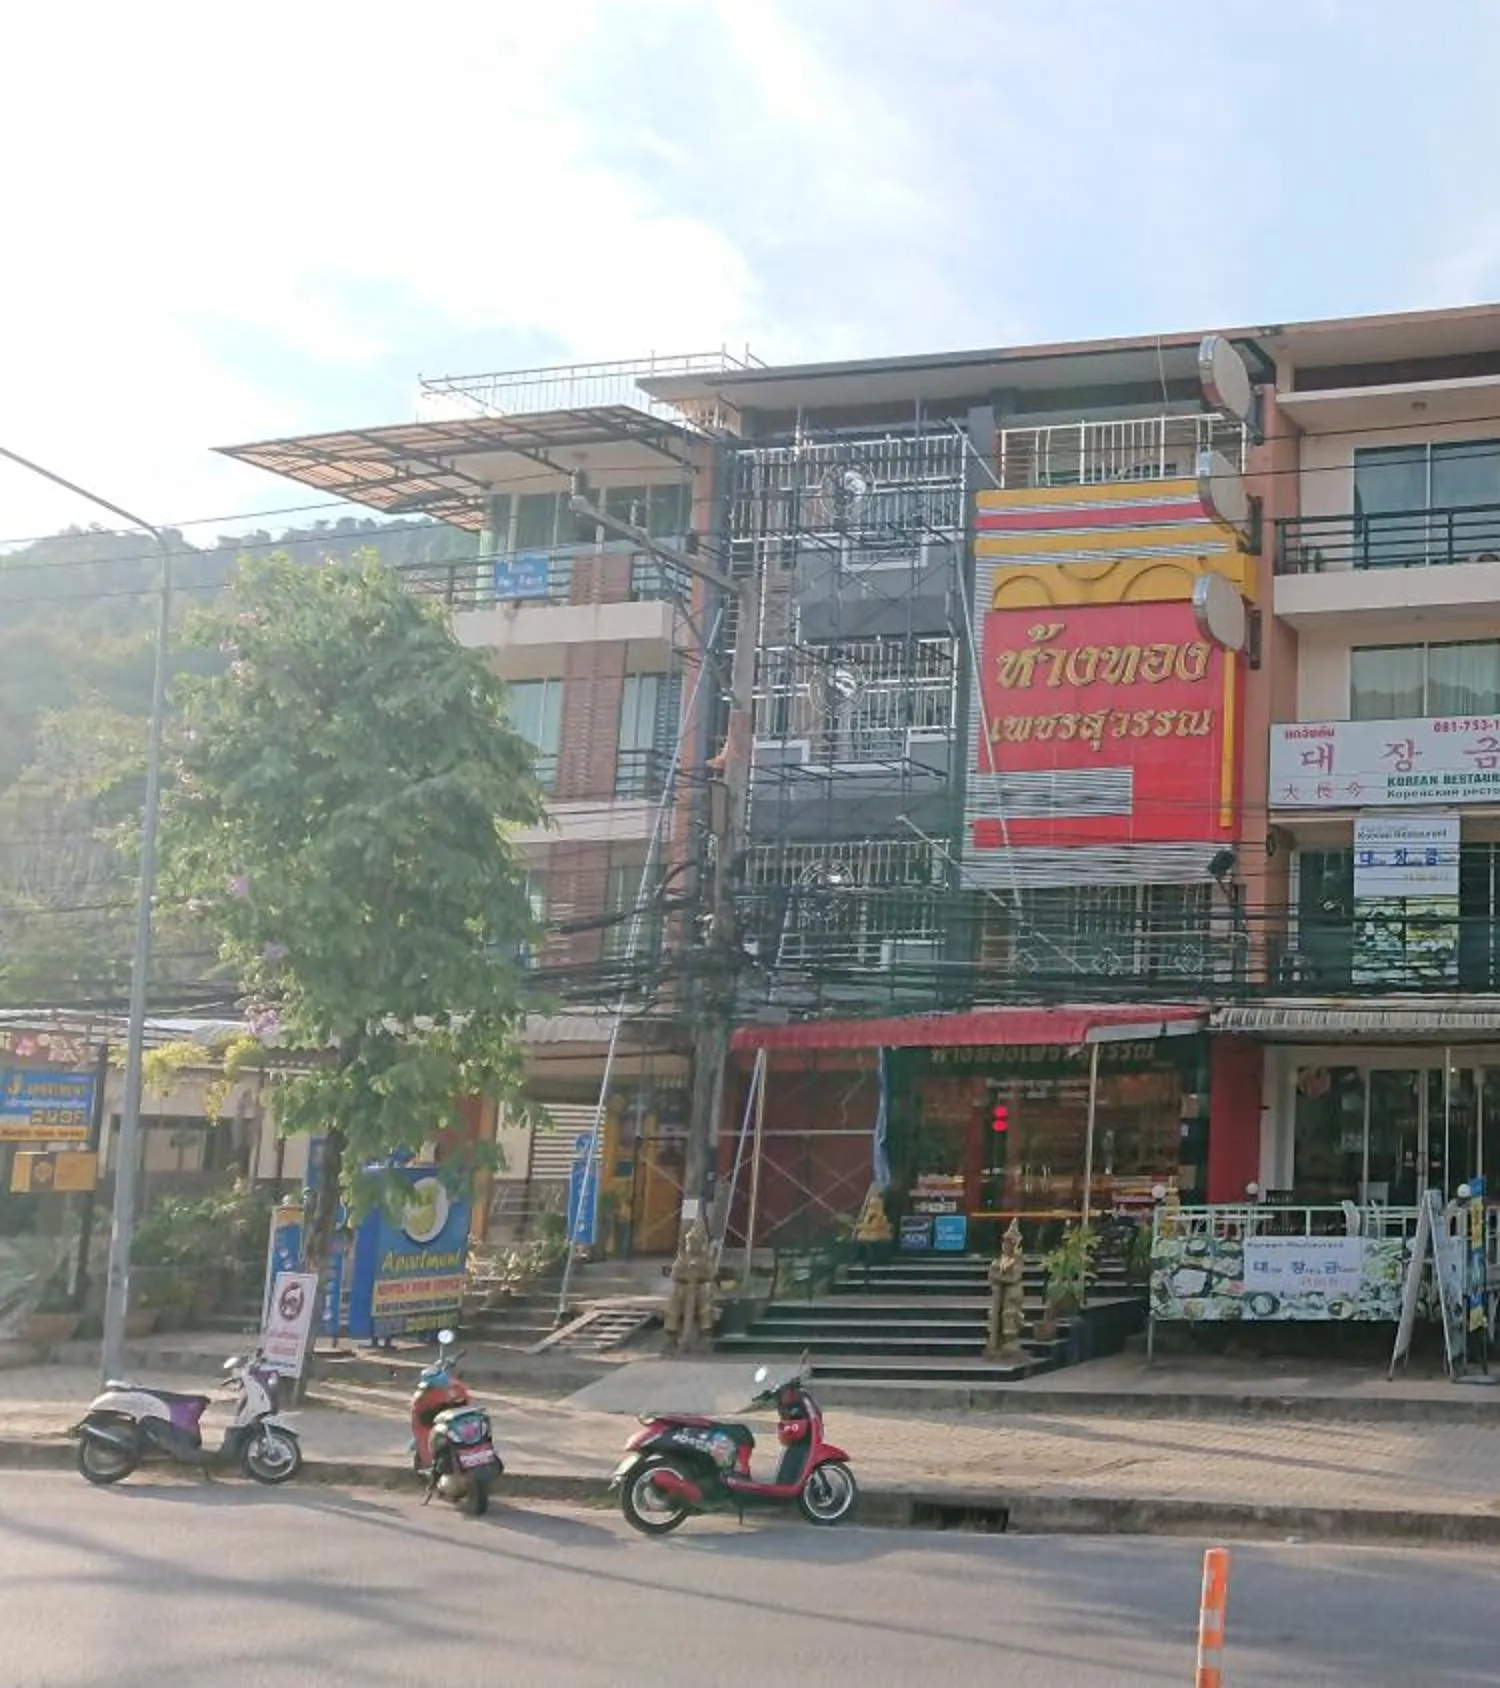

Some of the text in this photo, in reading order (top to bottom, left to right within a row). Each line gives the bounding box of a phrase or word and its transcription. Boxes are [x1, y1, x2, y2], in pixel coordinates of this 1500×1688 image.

[995, 622, 1213, 688] ห้างทอง
[989, 707, 1215, 752] เพชรสุวรรณ
[1387, 775, 1438, 787] KOREAN
